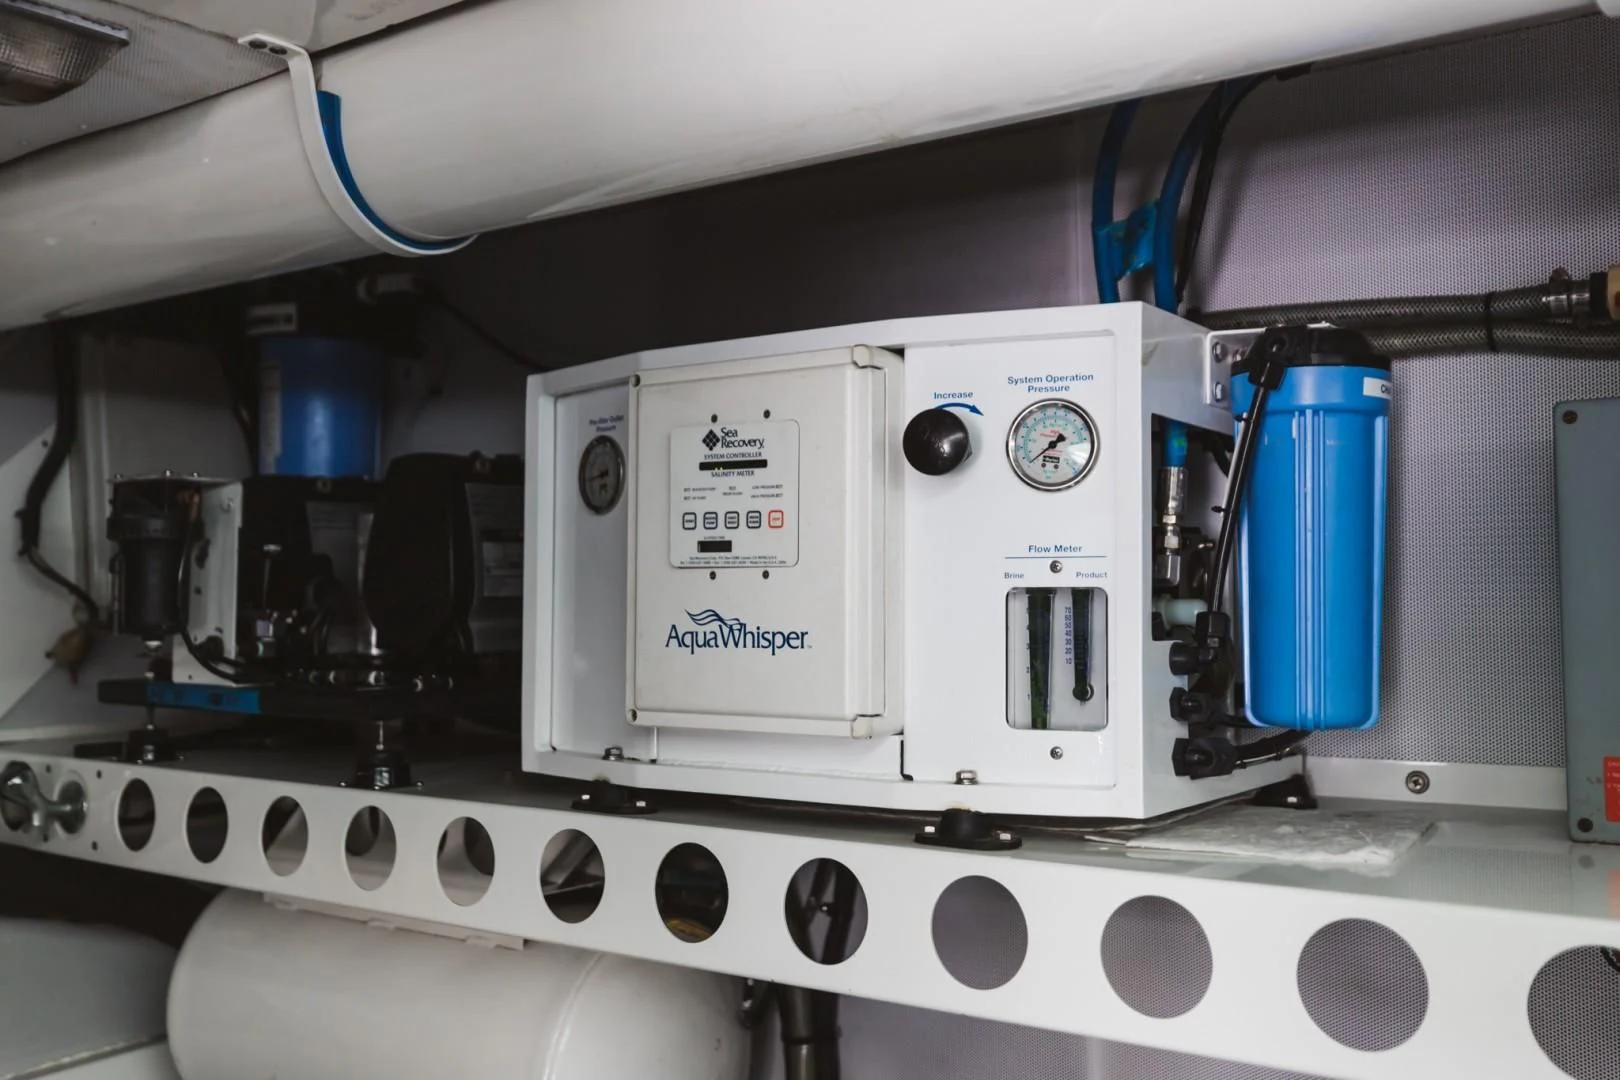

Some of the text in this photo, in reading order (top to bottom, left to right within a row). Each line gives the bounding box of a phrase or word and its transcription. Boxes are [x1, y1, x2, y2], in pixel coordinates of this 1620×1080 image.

[1007, 373, 1094, 386] System Operation
[1027, 384, 1070, 394] Pressure
[933, 391, 974, 400] Increase
[720, 427, 738, 438] Sea
[721, 437, 764, 450] Recovery
[726, 451, 762, 459] CONTROLLER
[711, 469, 755, 478] SALINITY METER
[1028, 544, 1082, 553] Flow Meter
[1003, 571, 1025, 579] Brine
[1075, 571, 1108, 579] Product
[664, 624, 809, 655] AquaWhisper
